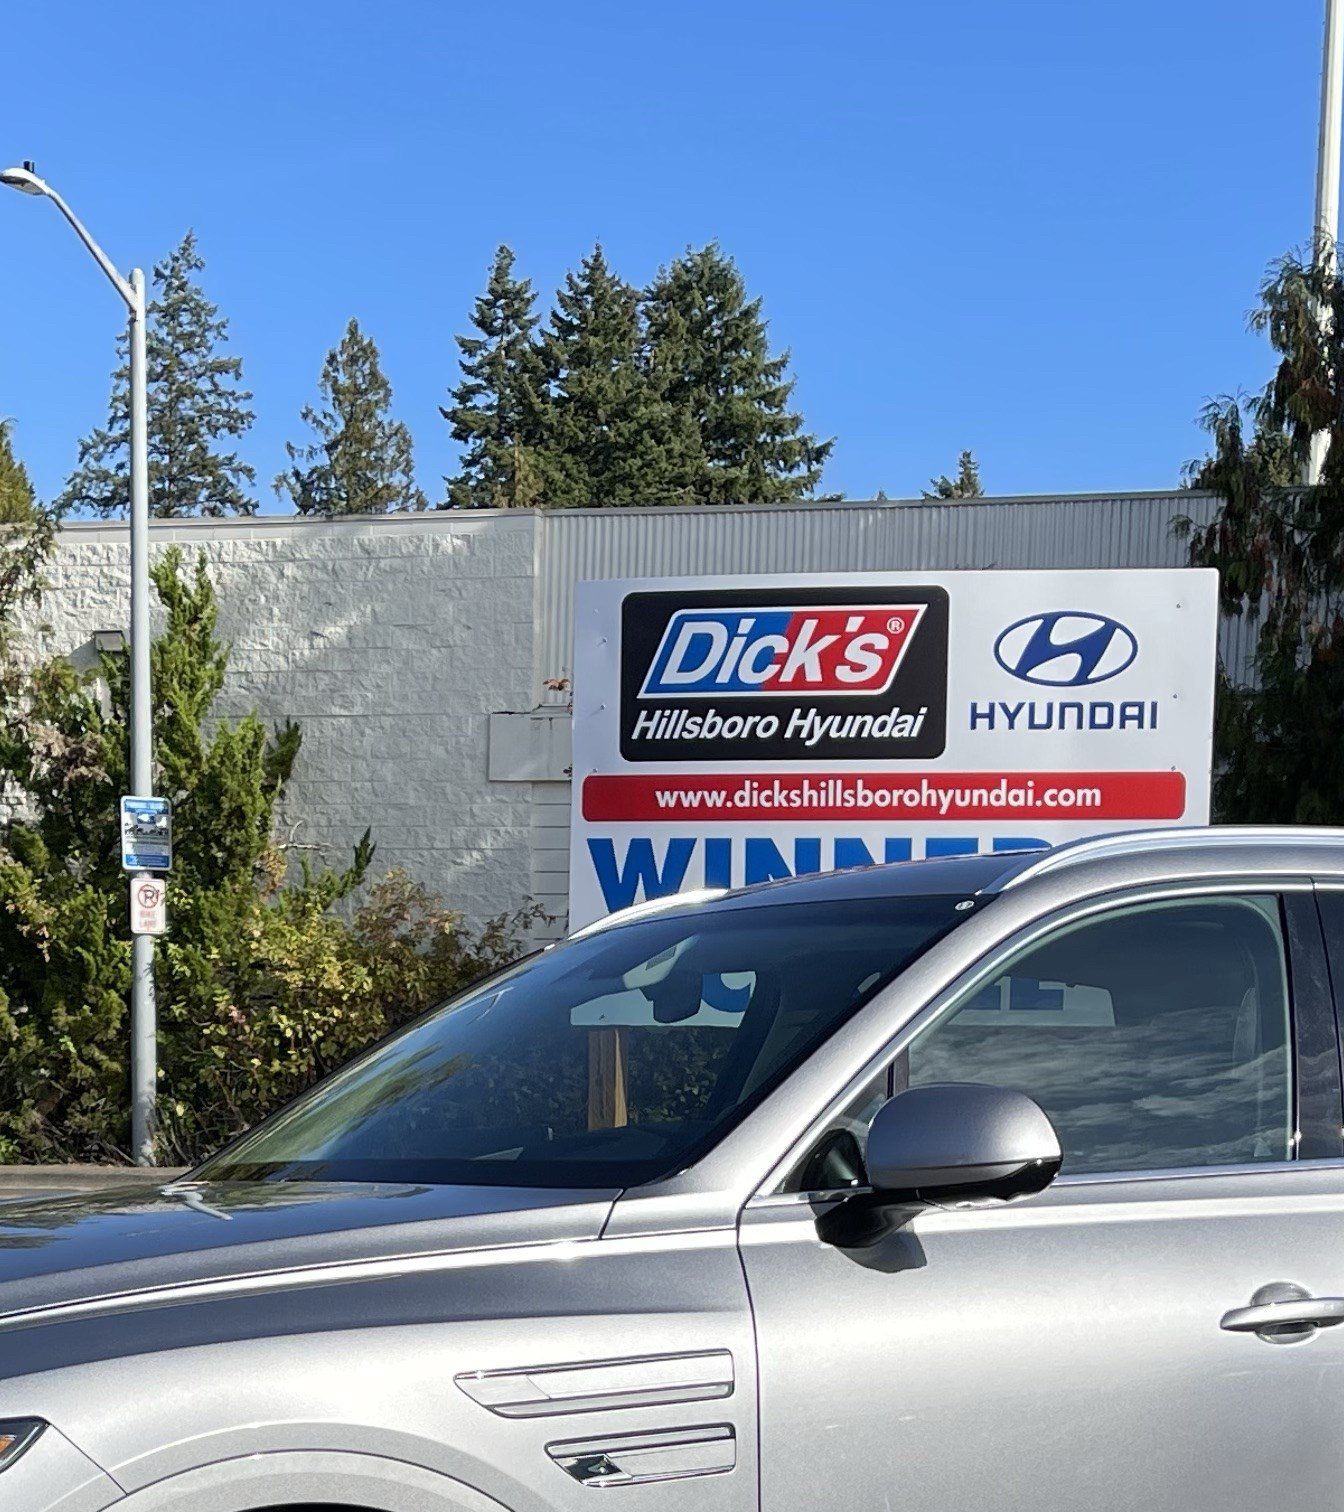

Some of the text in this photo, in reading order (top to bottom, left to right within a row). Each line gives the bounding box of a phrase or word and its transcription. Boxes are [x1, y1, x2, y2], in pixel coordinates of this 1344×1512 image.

[658, 616, 892, 685] Dick's
[631, 706, 928, 746] Hillsboro Hyundai
[970, 701, 1158, 731] HYUNDAI
[655, 778, 1102, 816] www.dickshillsborohyundai.com
